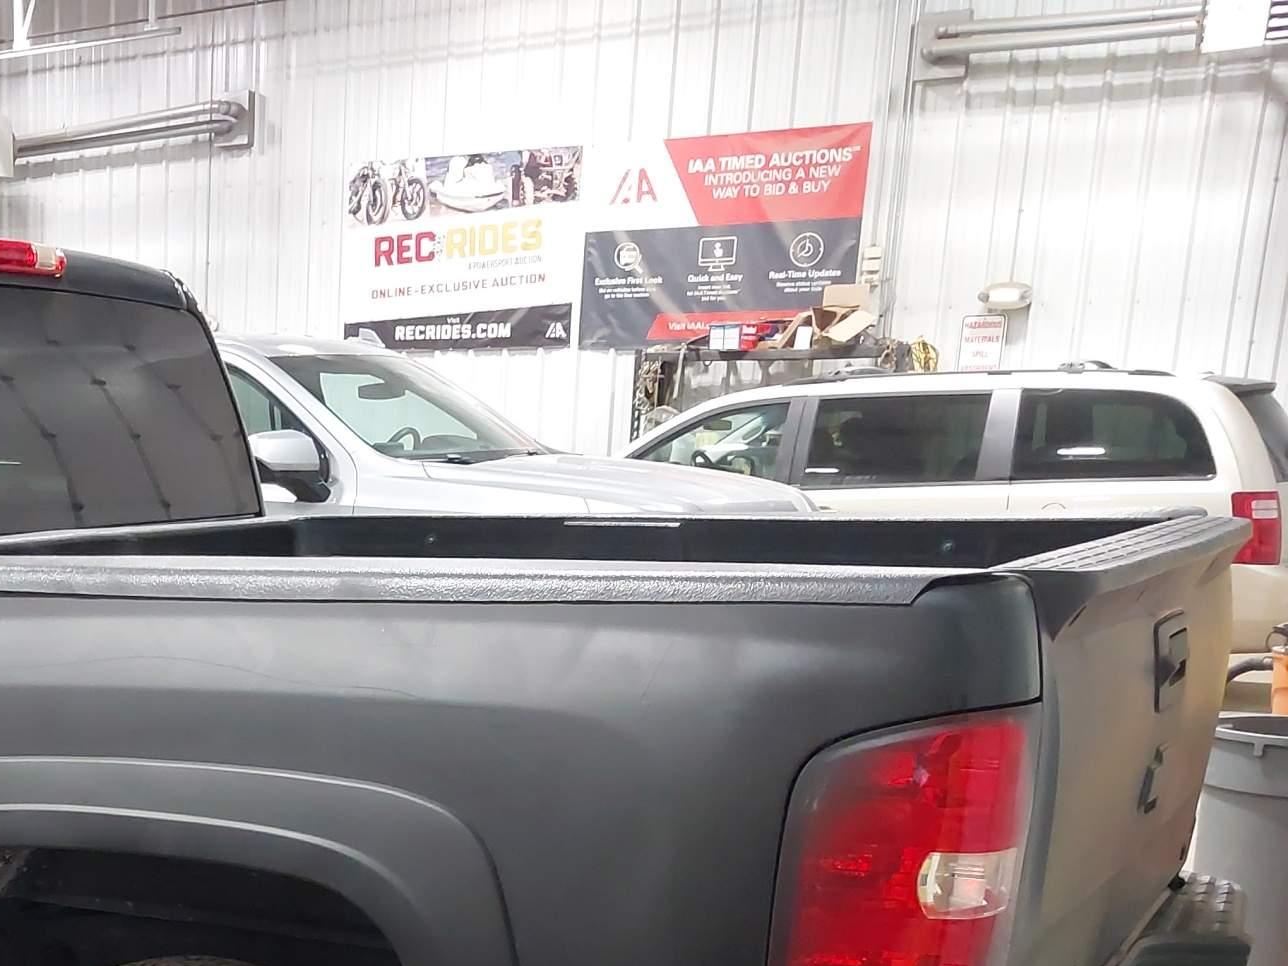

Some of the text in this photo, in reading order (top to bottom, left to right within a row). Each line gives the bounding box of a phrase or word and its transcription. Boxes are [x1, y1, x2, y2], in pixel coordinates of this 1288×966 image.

[688, 159, 716, 174] IAA
[719, 154, 763, 173] TIMED
[704, 165, 843, 186] INTRODUCING A NEW
[712, 179, 832, 200] WAY TO BID & BUY
[374, 219, 544, 267] REC RIDES
[627, 276, 644, 285] First
[687, 273, 744, 283] Quick and Easy
[768, 268, 841, 280] Real-Time Updates
[371, 273, 546, 300] ONLINE-EXCLUSIVE AUCTION
[446, 316, 460, 325] Visit
[394, 321, 512, 342] RECRIDES.COM
